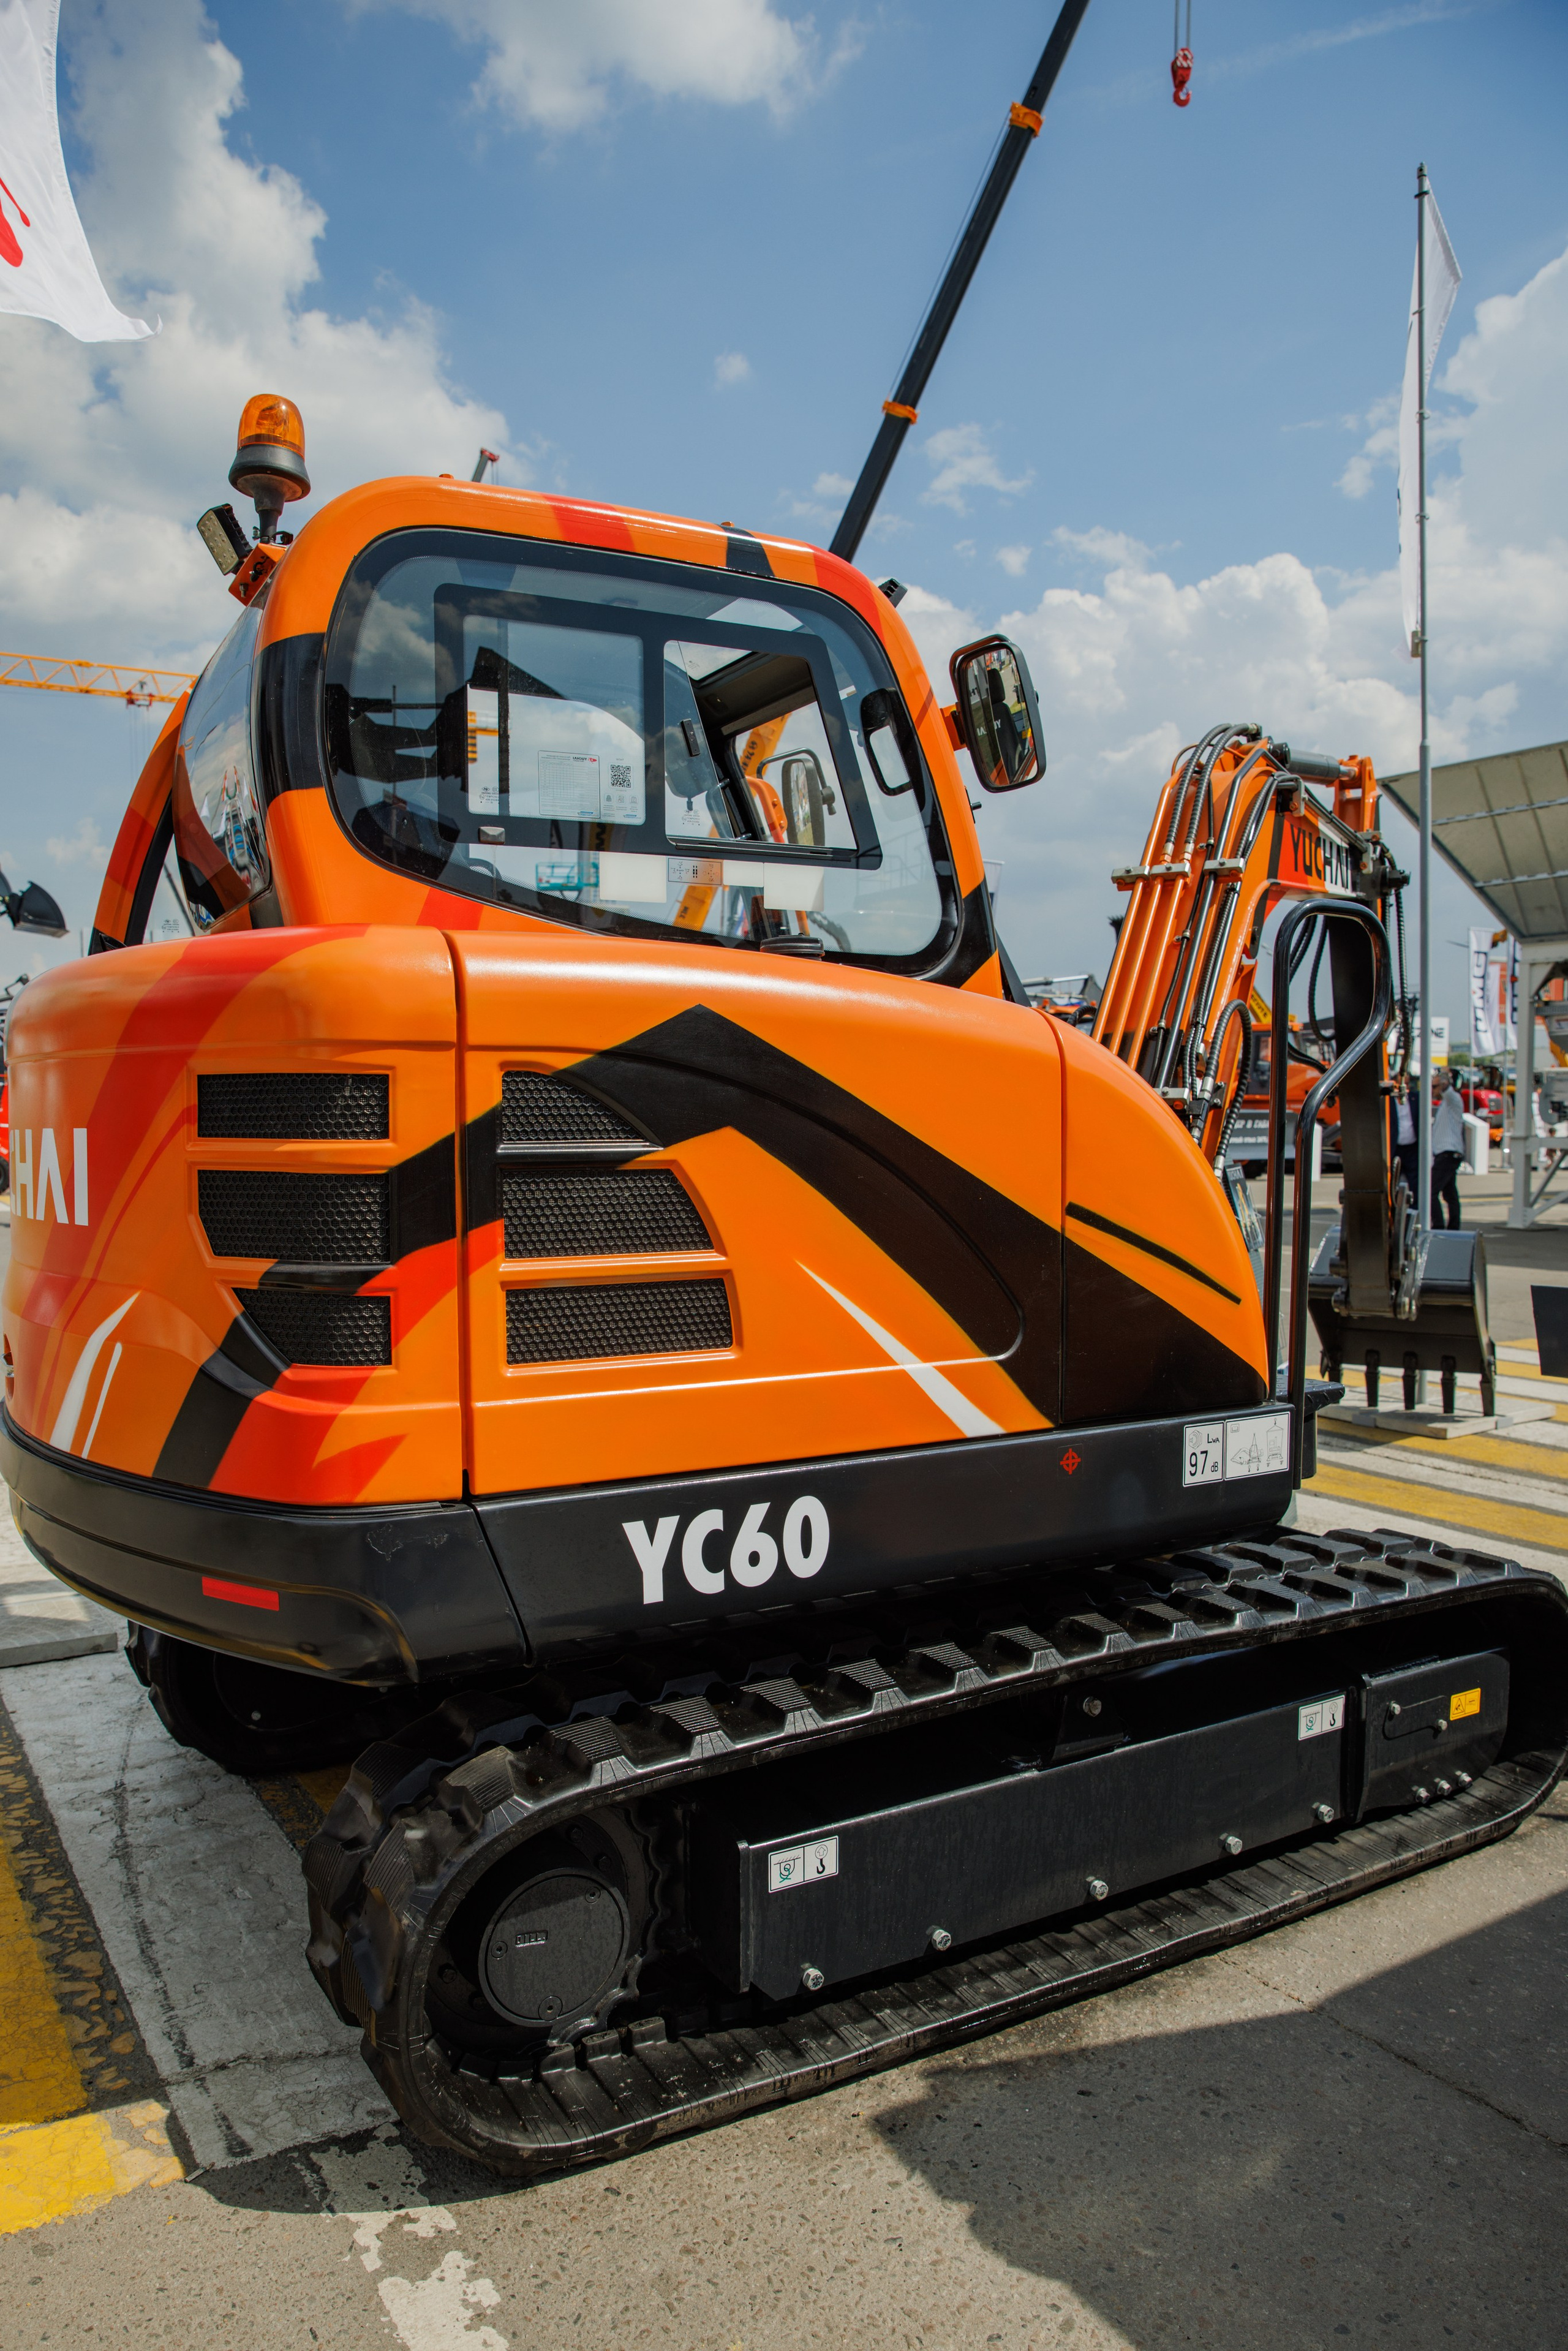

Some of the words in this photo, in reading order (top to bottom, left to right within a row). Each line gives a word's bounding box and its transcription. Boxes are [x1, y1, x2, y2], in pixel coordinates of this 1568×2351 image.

[1290, 823, 1350, 889] YUCHAI
[1189, 1450, 1208, 1477] 97
[1210, 1462, 1218, 1473] dB
[622, 1495, 830, 1605] YC60
